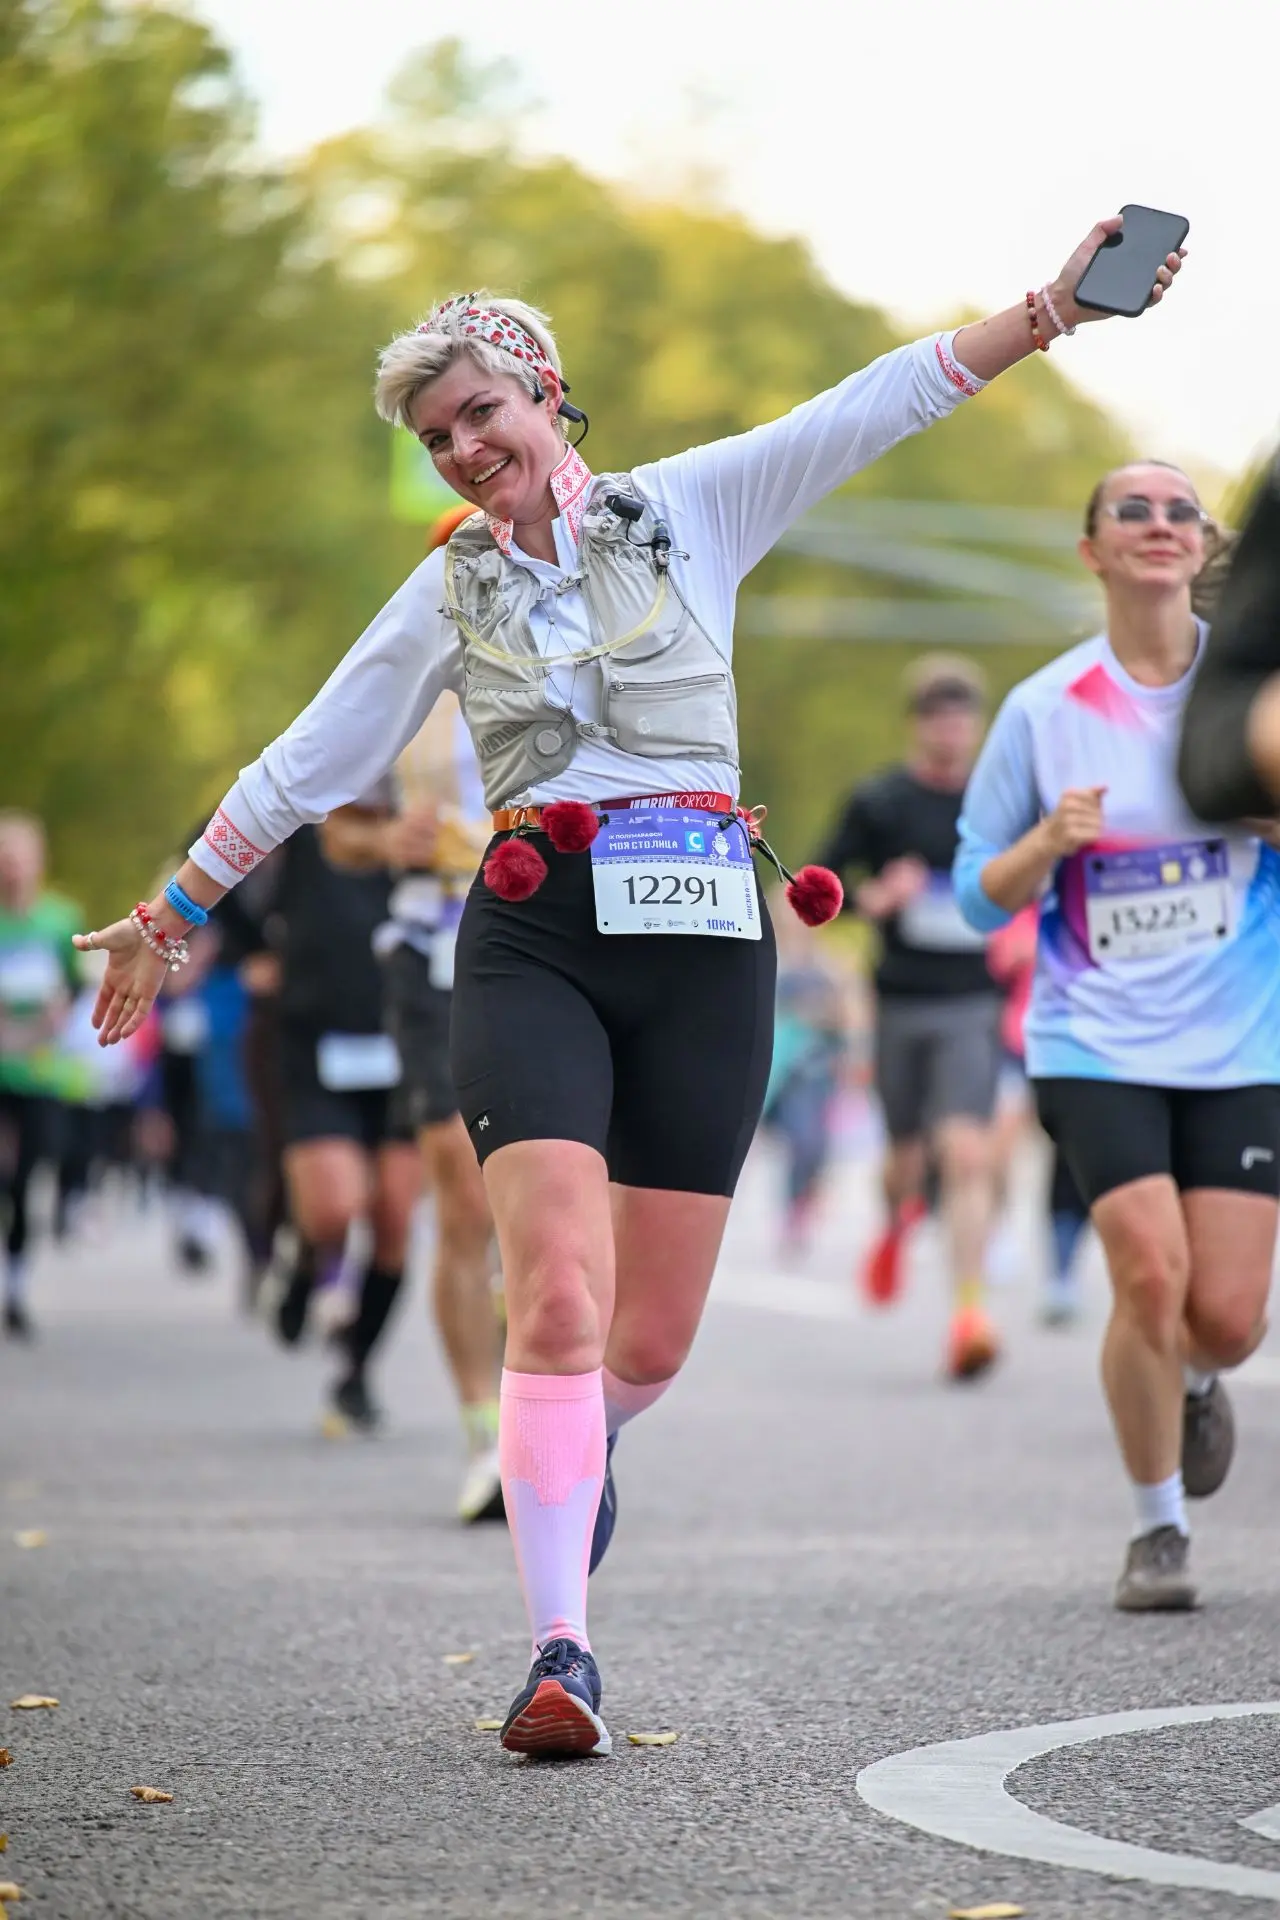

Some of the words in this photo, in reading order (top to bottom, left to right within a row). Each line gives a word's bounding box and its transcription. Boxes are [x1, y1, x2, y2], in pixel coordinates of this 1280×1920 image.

[609, 842, 631, 851] МОЯ
[631, 840, 678, 850] СТОЛИЦА
[622, 875, 718, 906] 12291
[706, 918, 735, 932] 10КМ
